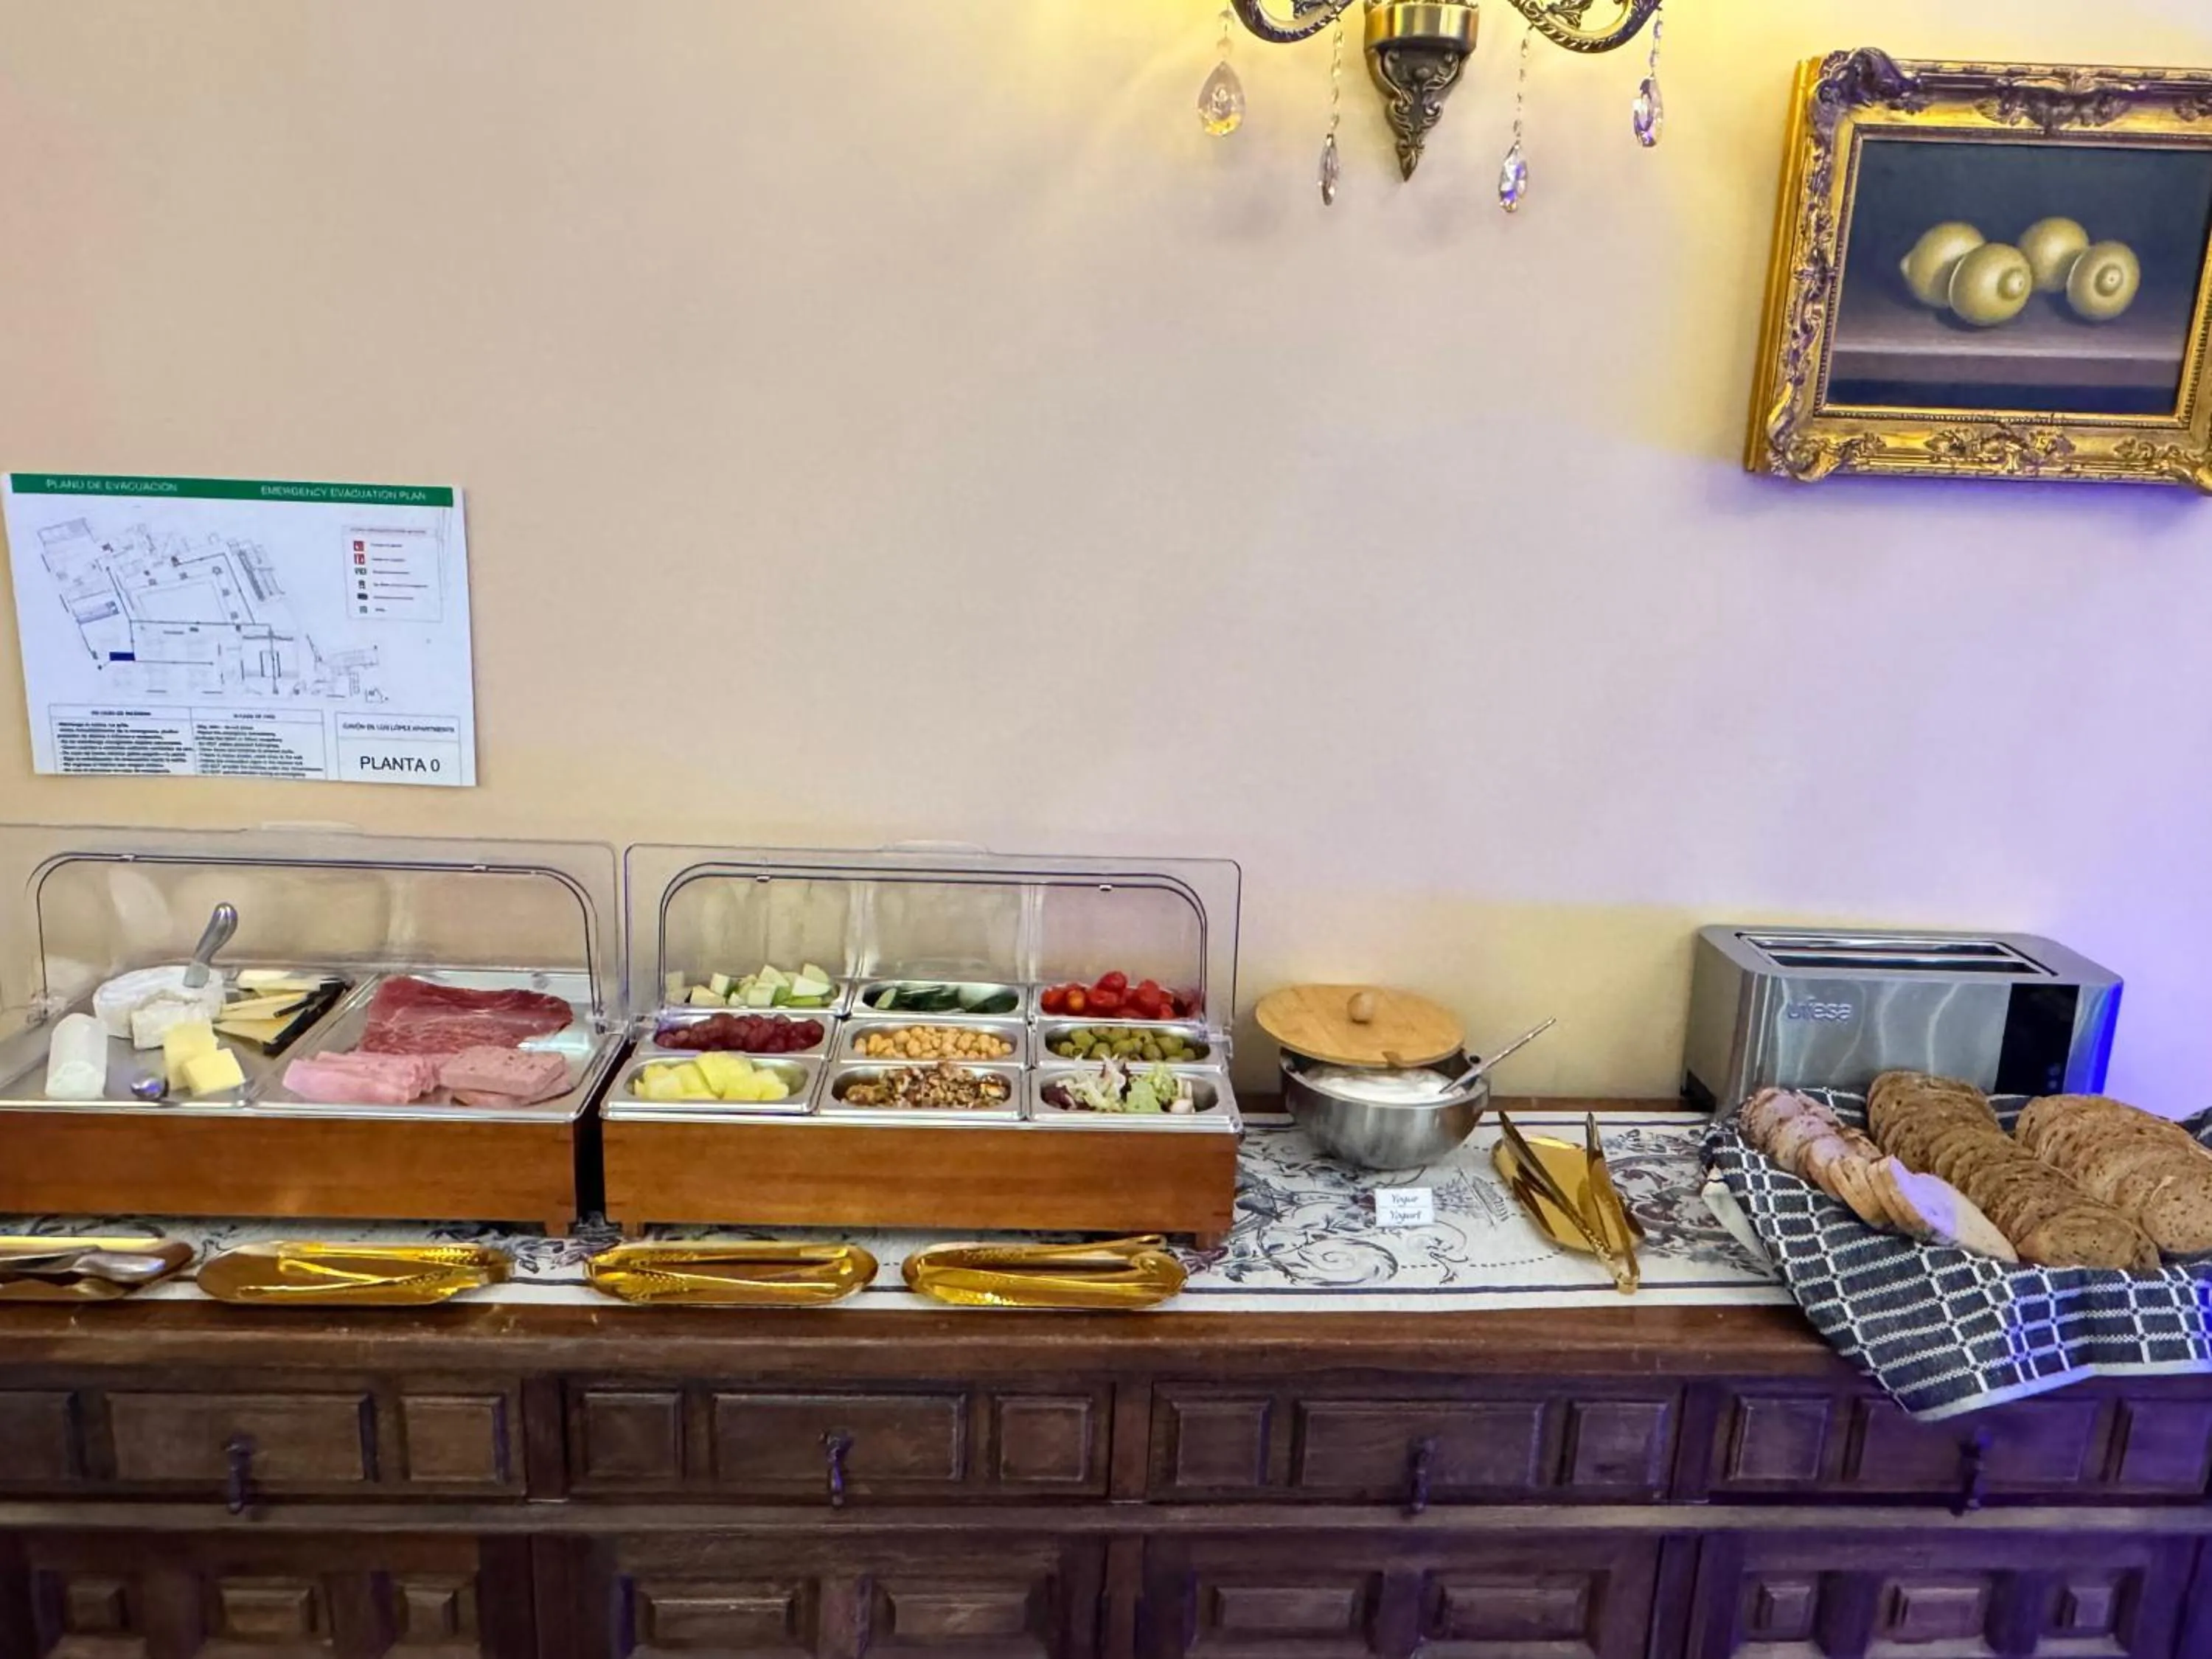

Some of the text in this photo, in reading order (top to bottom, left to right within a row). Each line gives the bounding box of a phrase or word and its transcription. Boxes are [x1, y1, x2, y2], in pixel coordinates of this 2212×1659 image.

[46, 479, 85, 490] PLANO
[87, 480, 101, 490] DE
[261, 485, 426, 501] EMERGENCY EVACUATION PLAN
[360, 756, 440, 772] PLANTA 0
